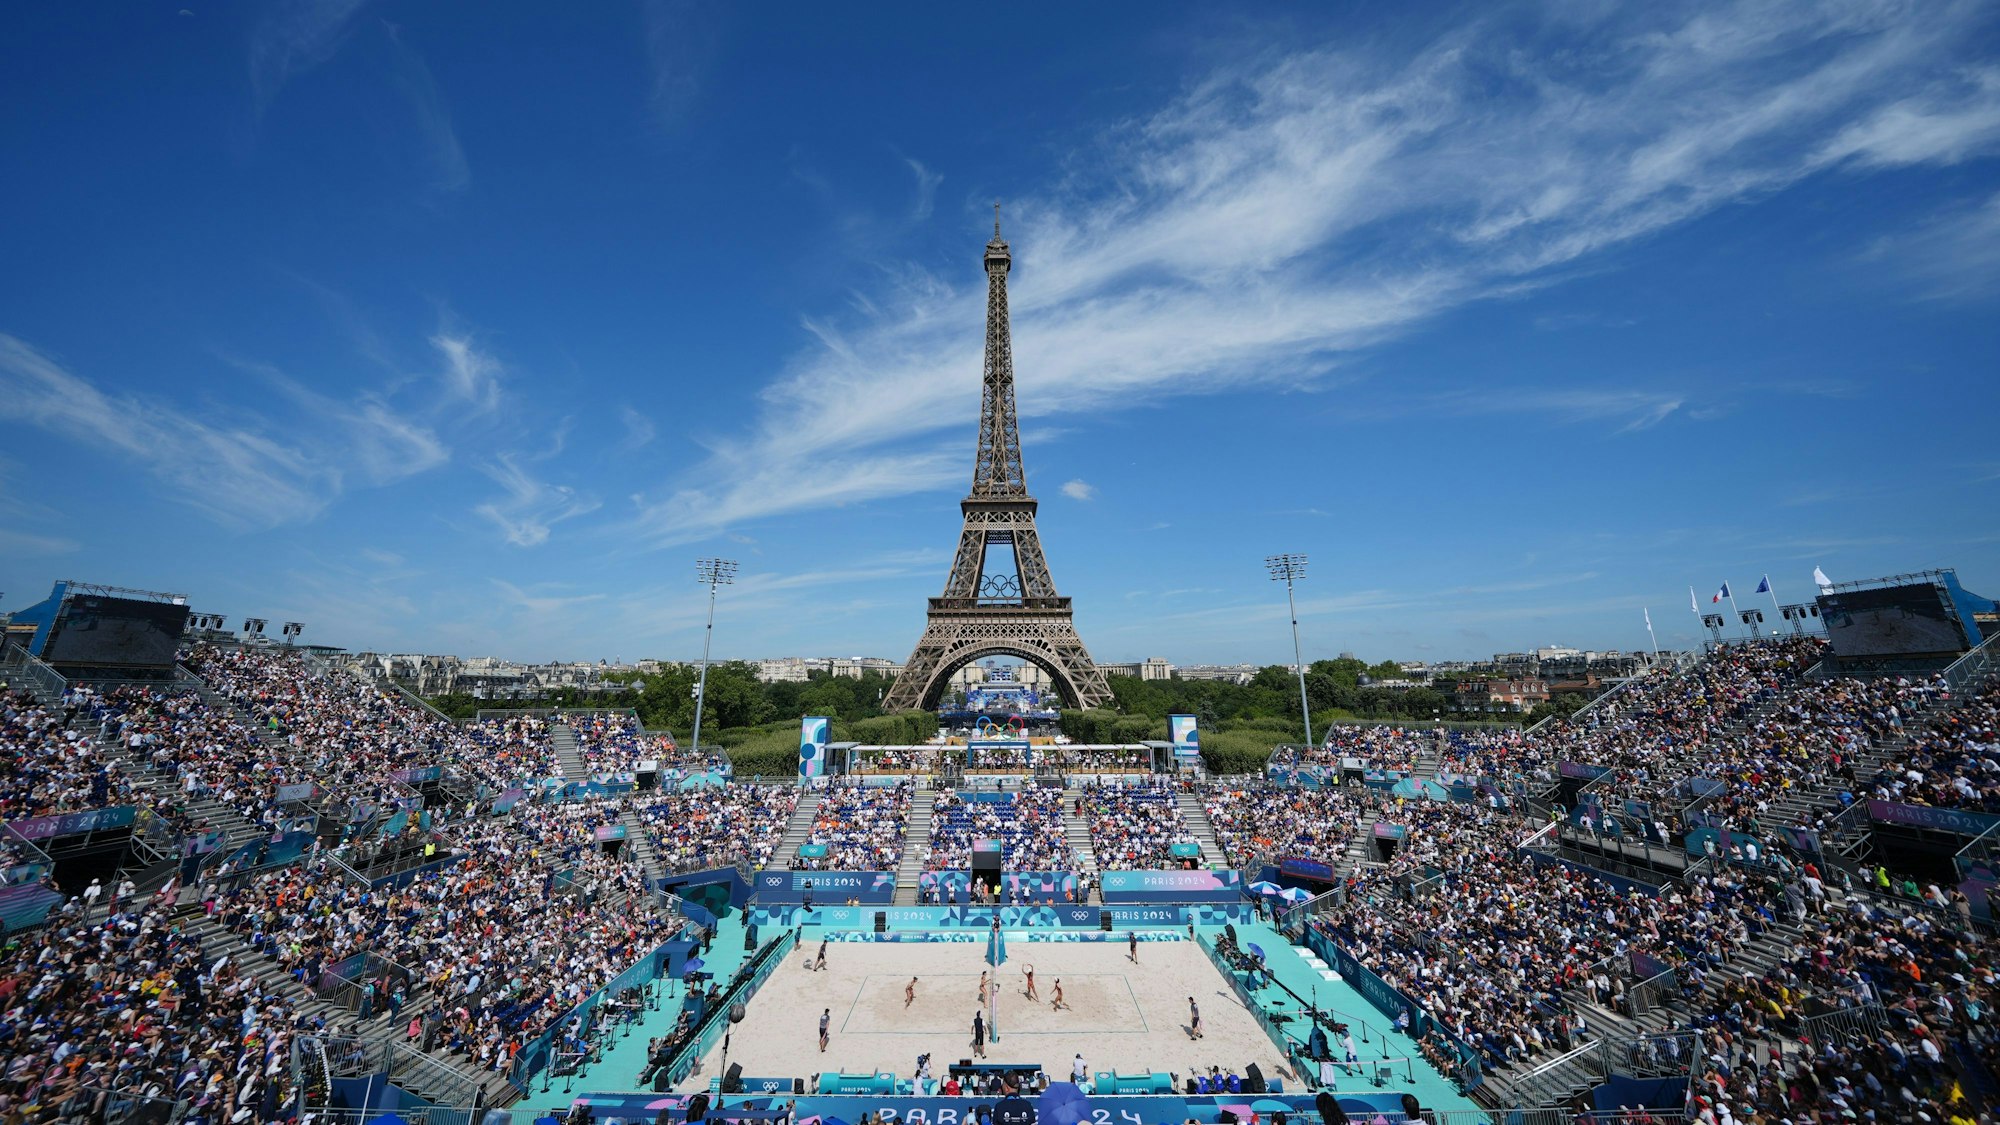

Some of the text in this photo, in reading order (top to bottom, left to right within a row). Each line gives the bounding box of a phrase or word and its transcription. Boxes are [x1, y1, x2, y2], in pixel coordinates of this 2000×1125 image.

[1887, 806, 1986, 830] PARIS 2024
[24, 813, 119, 835] PARIS 2024
[800, 877, 862, 887] PARIS 2024
[1144, 877, 1205, 886] PARIS 2024
[868, 911, 932, 920] PIS 2024
[1142, 911, 1172, 920] 2024
[1365, 978, 1387, 1004] PARIS
